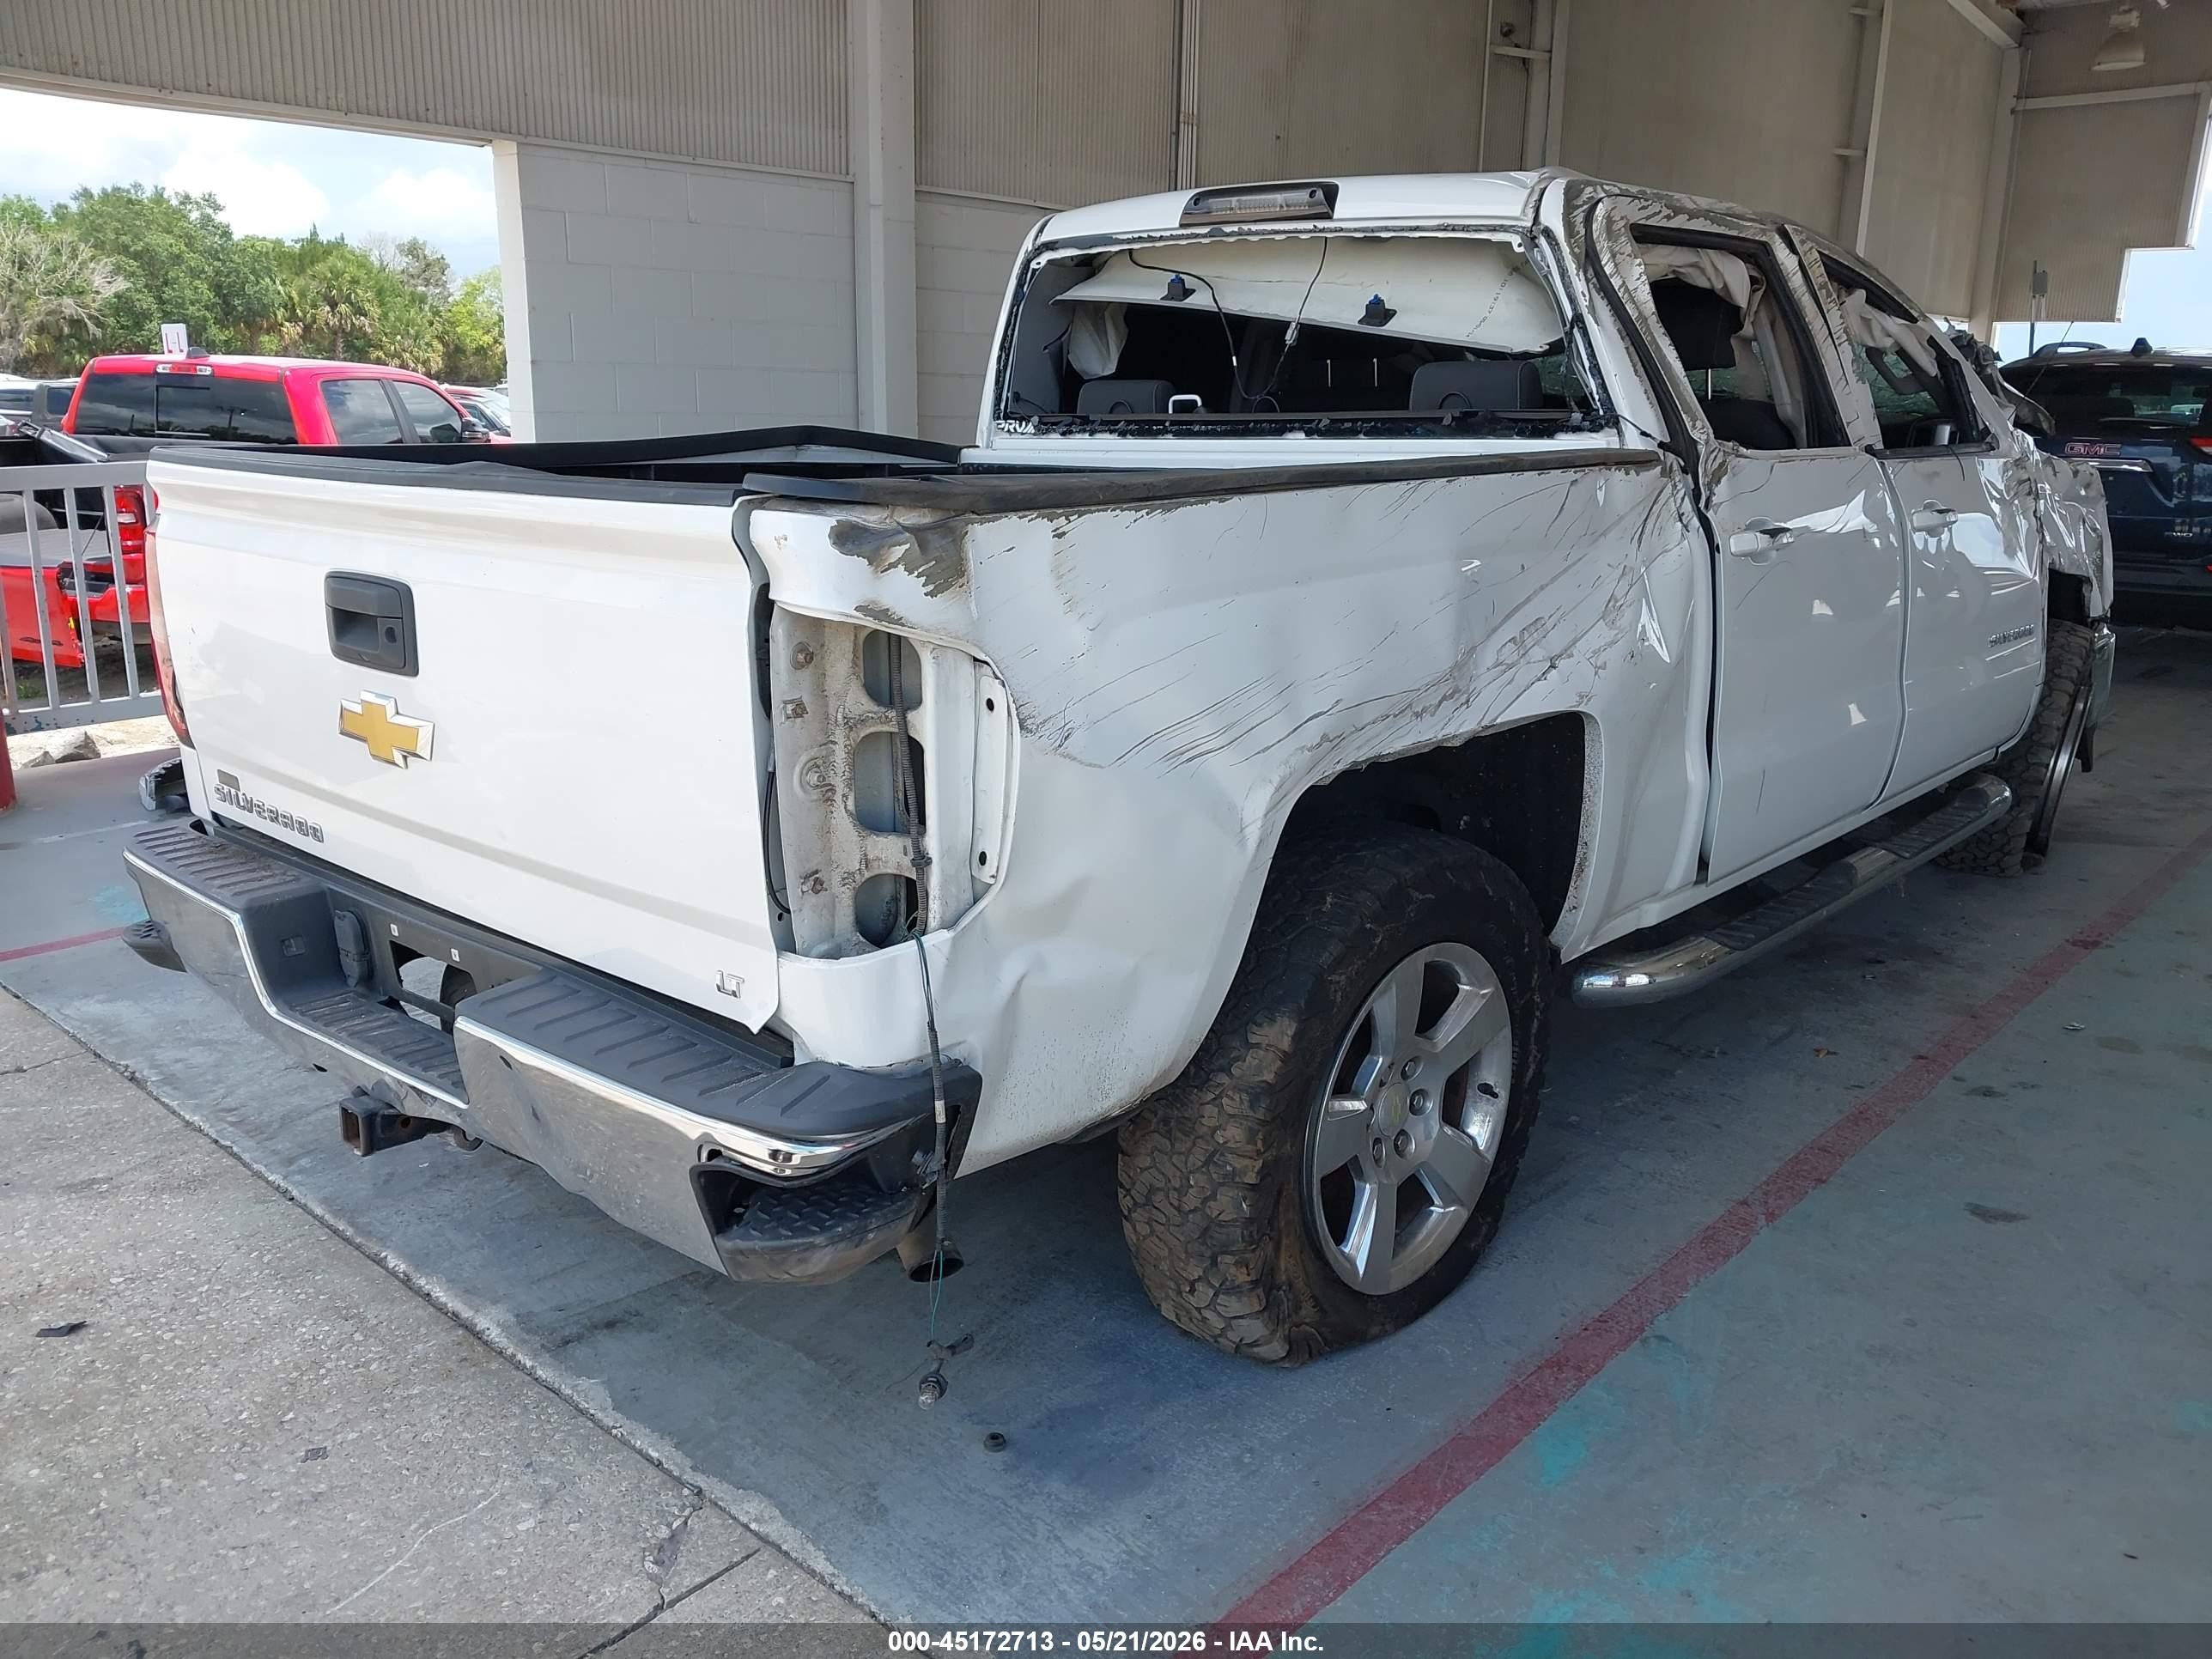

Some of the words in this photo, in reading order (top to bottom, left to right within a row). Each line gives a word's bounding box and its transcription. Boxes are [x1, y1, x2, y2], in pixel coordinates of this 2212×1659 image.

[2065, 442, 2122, 455] GMC
[214, 783, 325, 843] SILVERADO
[715, 969, 744, 999] LT
